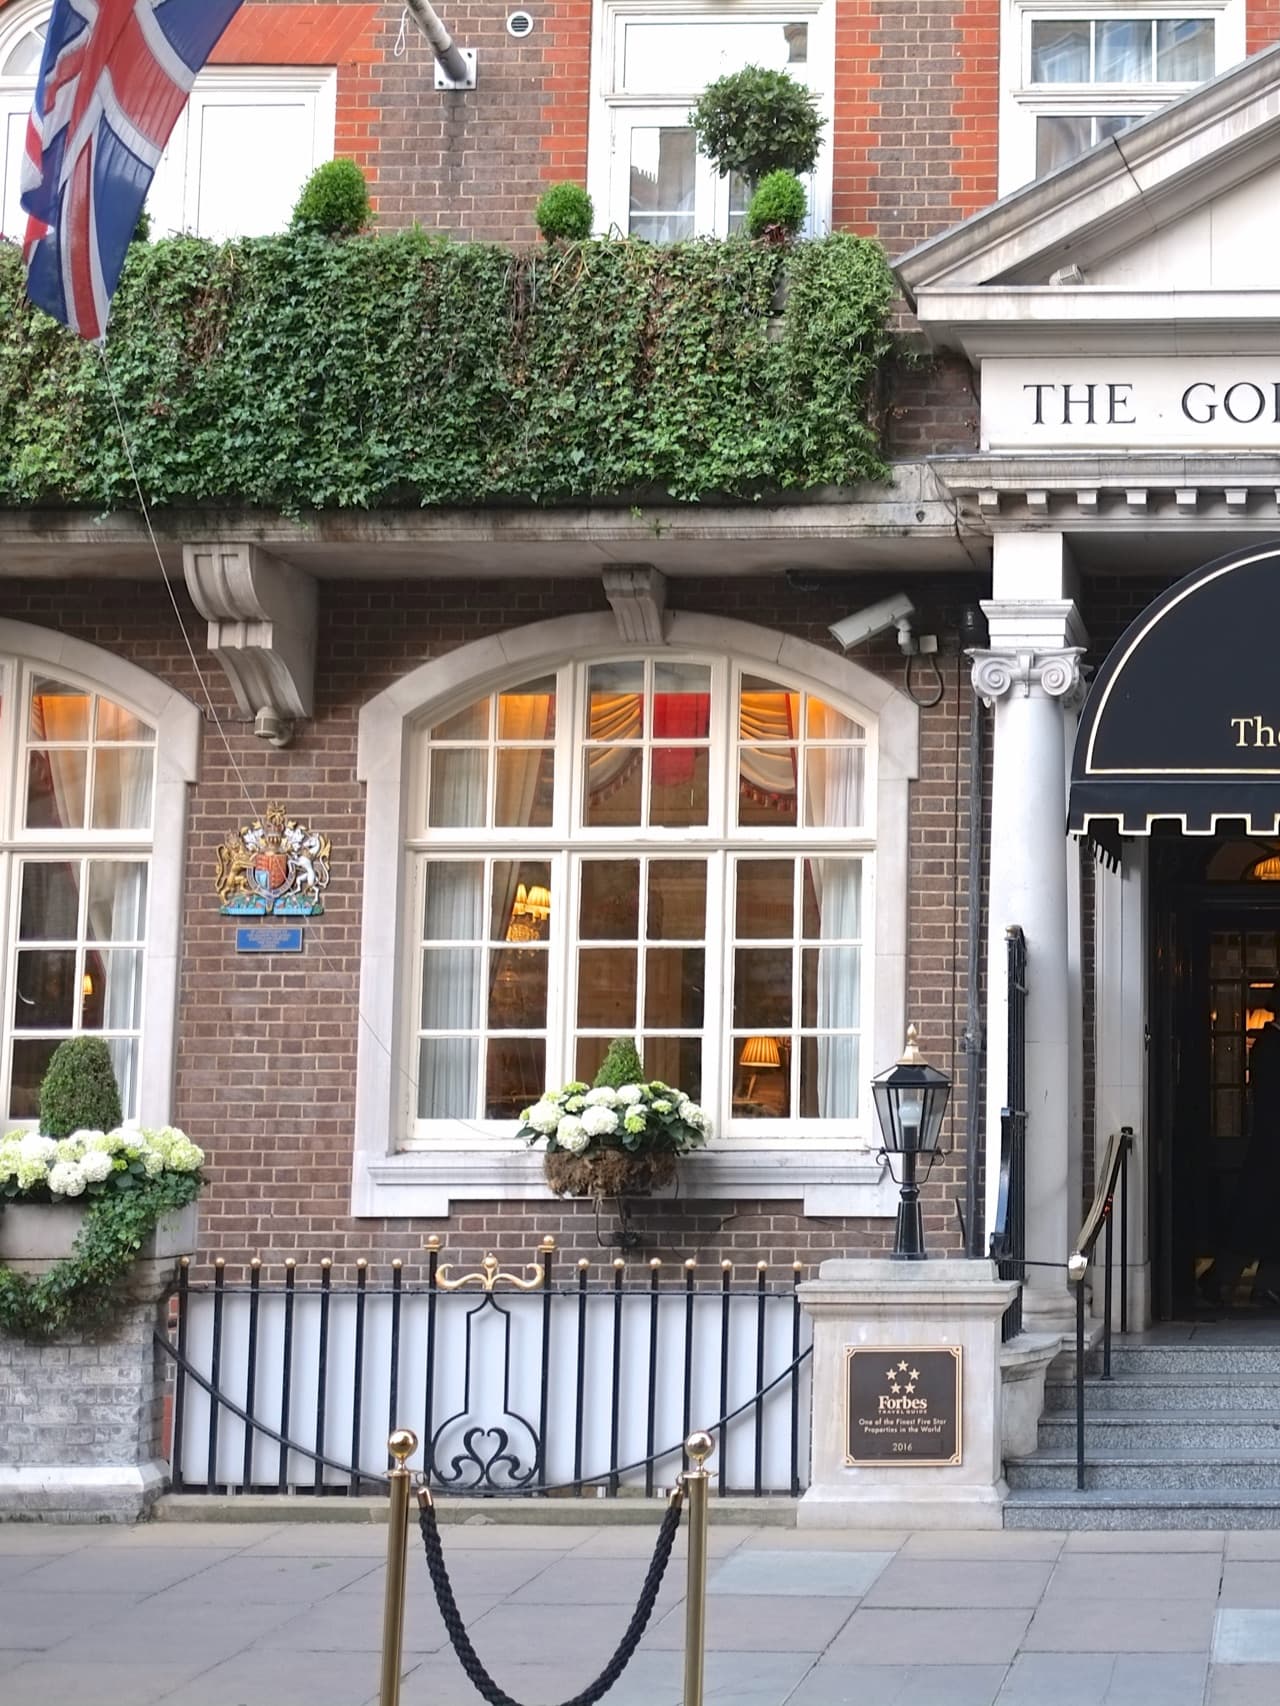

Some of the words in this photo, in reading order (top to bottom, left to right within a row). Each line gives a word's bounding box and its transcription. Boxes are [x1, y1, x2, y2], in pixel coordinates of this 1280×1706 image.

[1023, 383, 1136, 425] THE
[878, 1395, 928, 1409] Forbes
[864, 1426, 898, 1434] Properties
[892, 1442, 913, 1452] 2016
